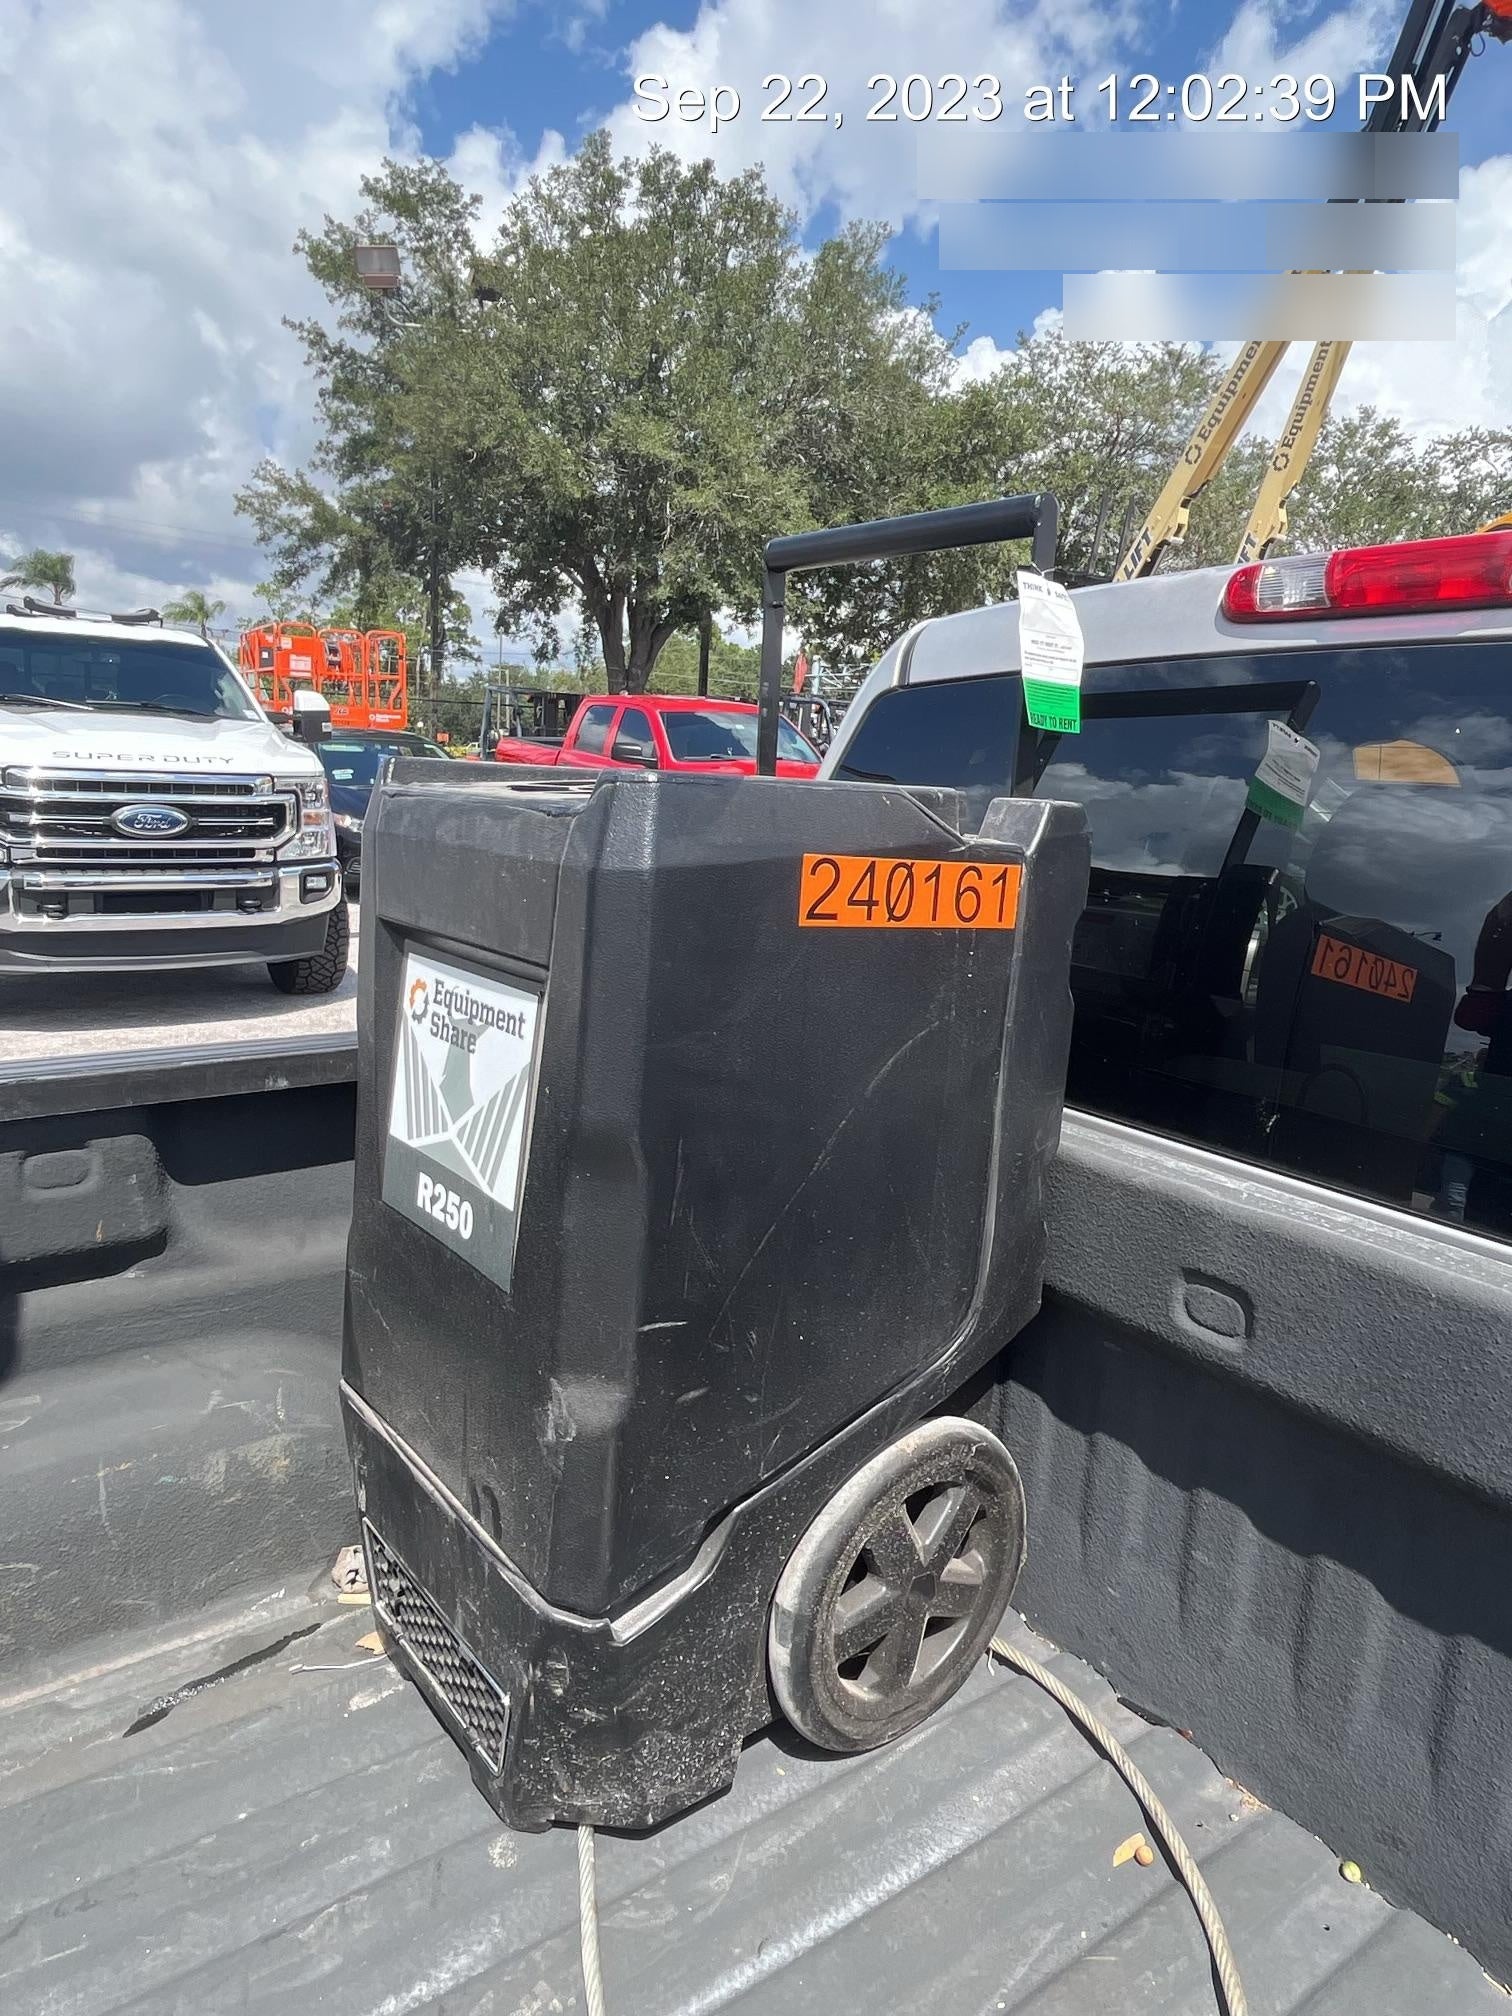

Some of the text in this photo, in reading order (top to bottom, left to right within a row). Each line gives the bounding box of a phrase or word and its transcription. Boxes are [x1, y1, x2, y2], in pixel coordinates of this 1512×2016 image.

[1281, 340, 1333, 450] Equipment
[1048, 715, 1058, 729] TO
[1059, 718, 1078, 731] RENT
[52, 750, 235, 765] SUPER DUTY
[134, 814, 172, 830] Ford
[805, 856, 1009, 924] 240161
[430, 1012, 477, 1054] Share
[433, 978, 526, 1040] Equipment
[416, 1171, 474, 1240] R250
